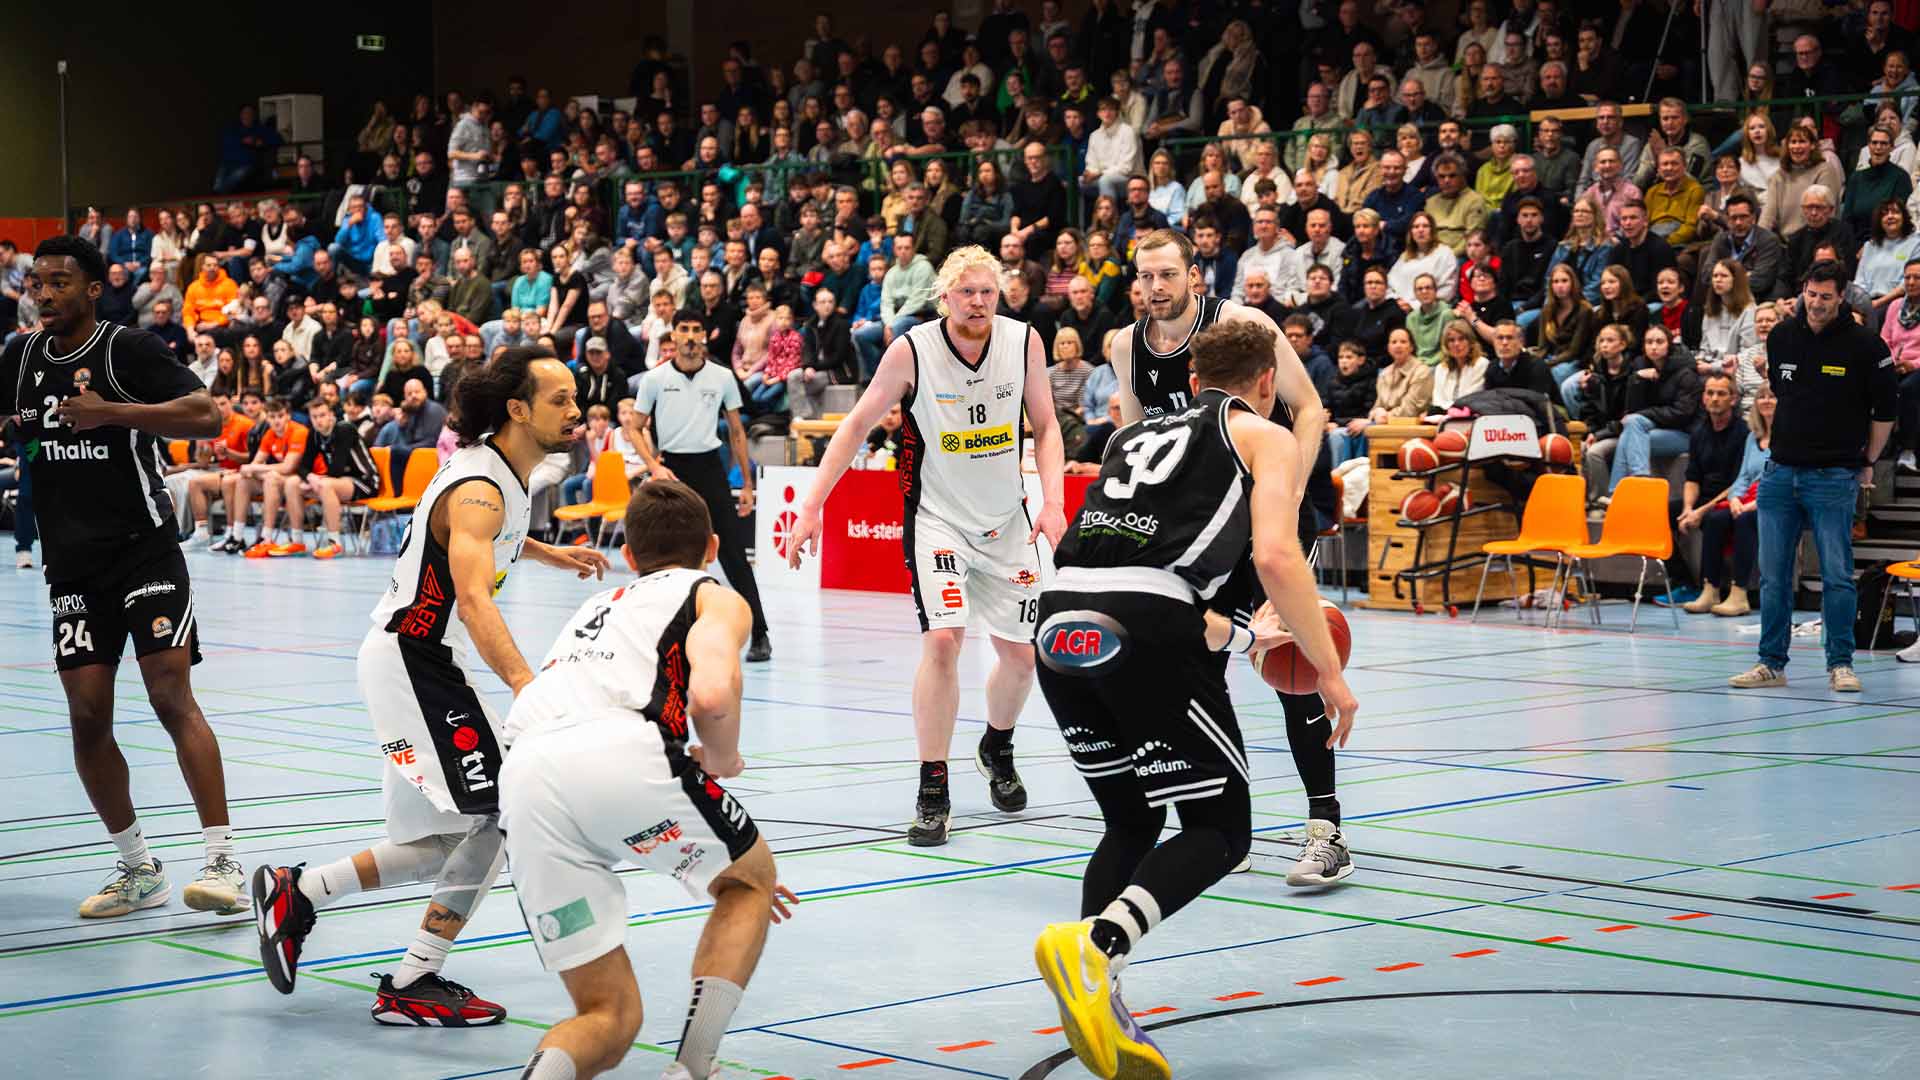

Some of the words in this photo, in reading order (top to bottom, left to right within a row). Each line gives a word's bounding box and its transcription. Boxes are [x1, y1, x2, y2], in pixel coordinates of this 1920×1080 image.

[967, 403, 987, 425] 18
[964, 431, 1012, 450] BÖRGEL
[1484, 428, 1527, 442] Wilson
[41, 440, 109, 461] Thalia
[1103, 425, 1192, 499] 30
[1018, 598, 1038, 623] 18
[59, 620, 94, 657] 24
[1051, 628, 1103, 656] ACR
[1070, 739, 1117, 754] edium.
[623, 818, 679, 846] DIESEL
